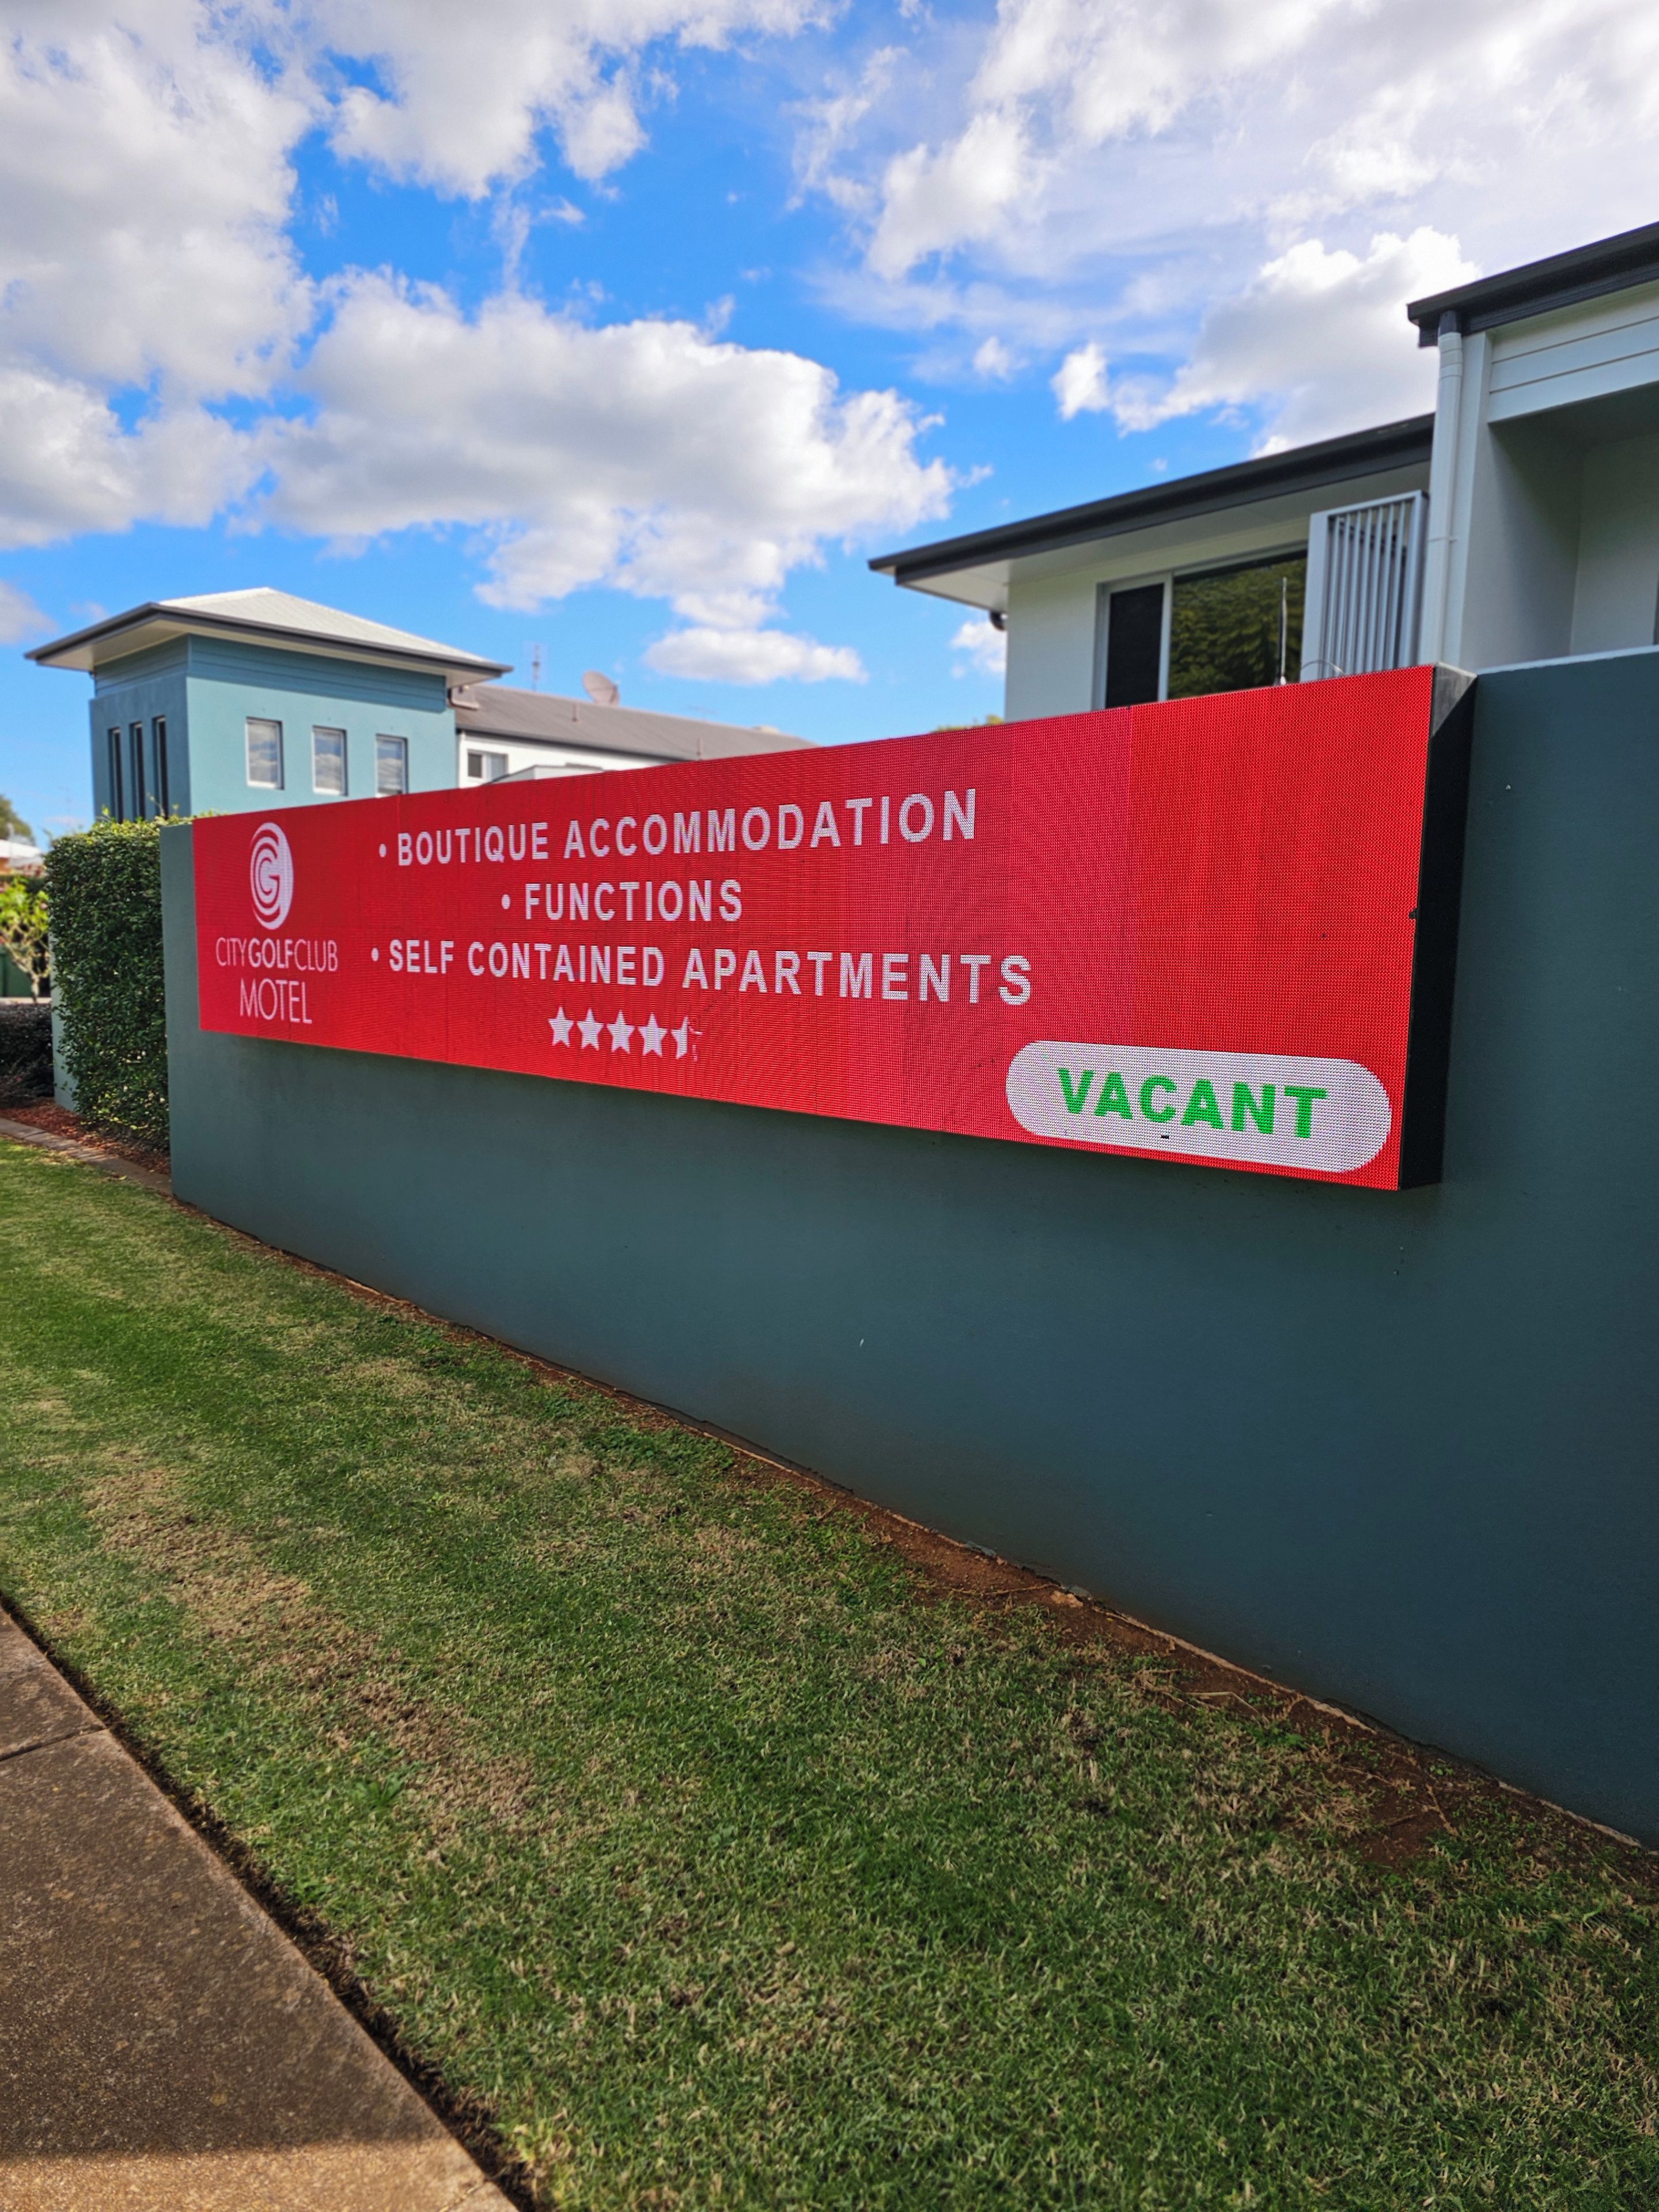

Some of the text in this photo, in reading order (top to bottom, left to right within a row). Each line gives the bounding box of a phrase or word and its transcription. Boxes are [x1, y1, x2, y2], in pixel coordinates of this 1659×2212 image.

[397, 787, 976, 866] BOUTIQUE ACCOMMODATION
[525, 878, 743, 922] FUNCTIONS
[239, 978, 313, 1024] MOTEL
[389, 938, 1032, 1006] SELF CONTAINED APARTMENTS
[1056, 1067, 1329, 1139] VACANT
